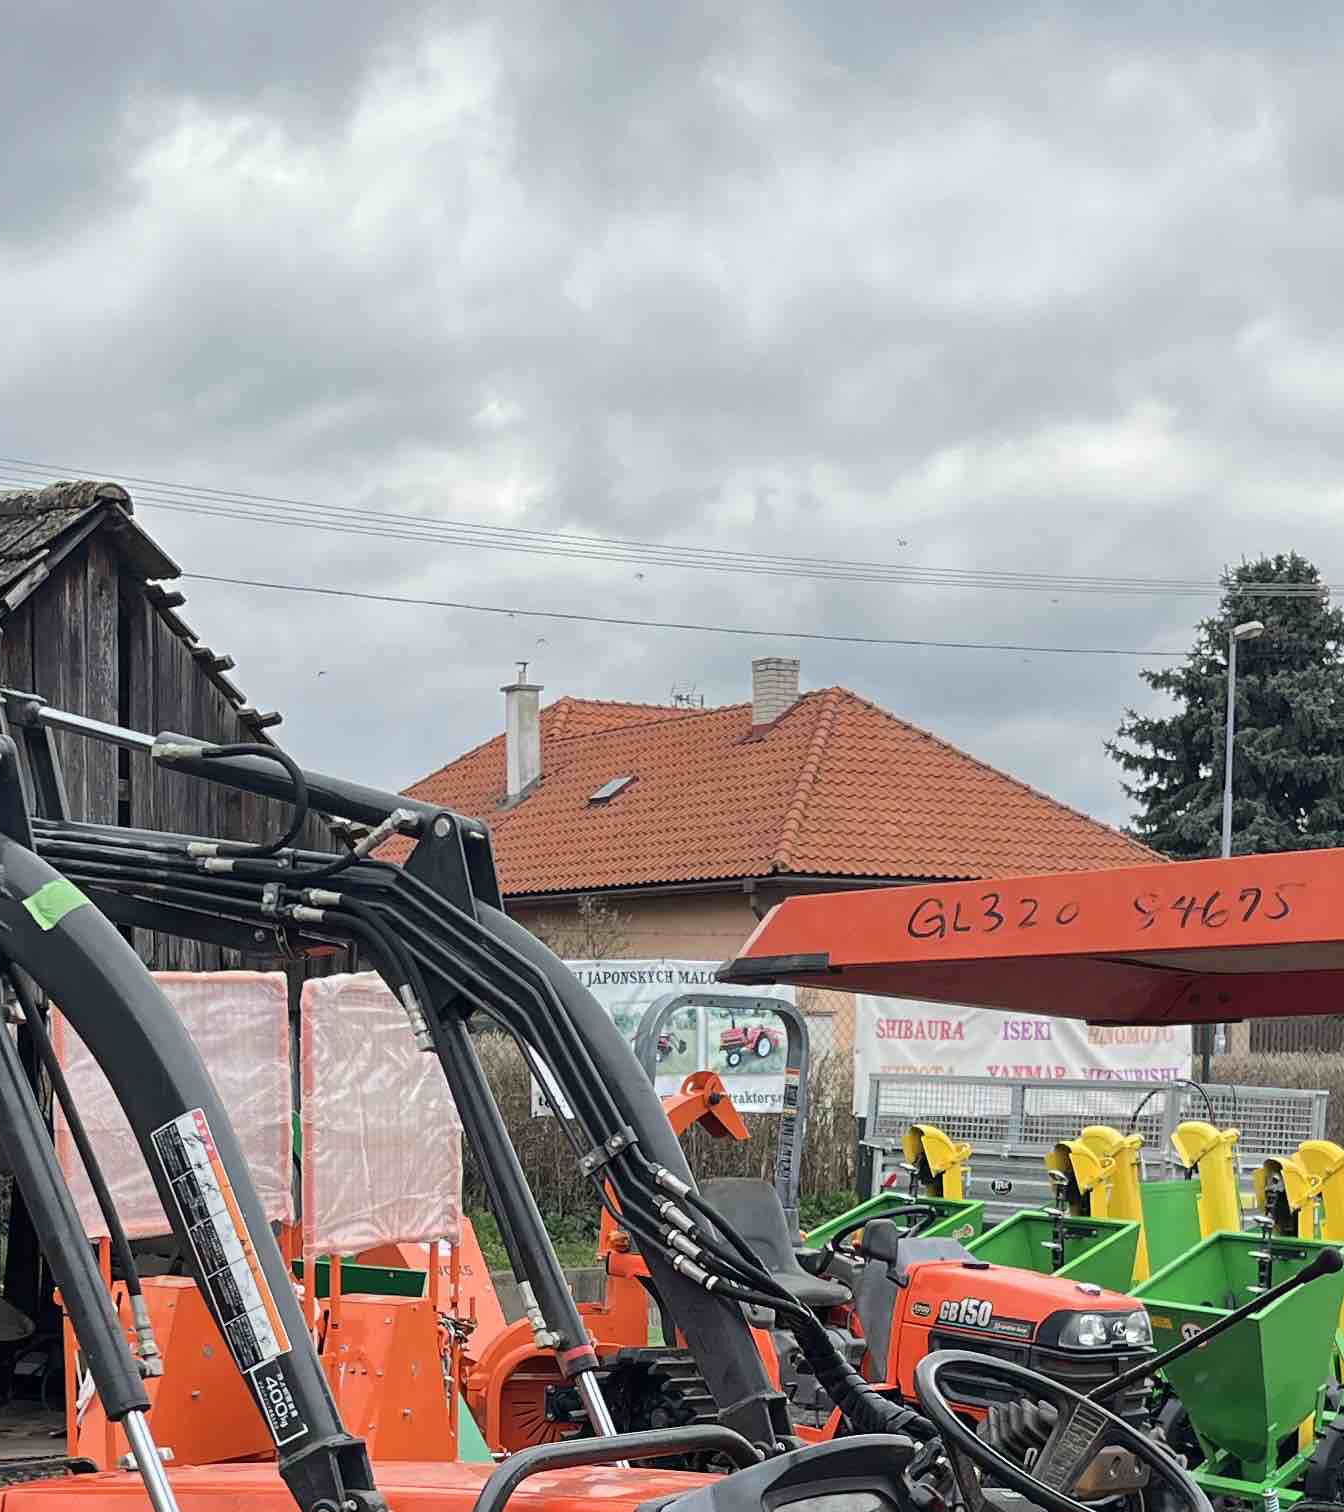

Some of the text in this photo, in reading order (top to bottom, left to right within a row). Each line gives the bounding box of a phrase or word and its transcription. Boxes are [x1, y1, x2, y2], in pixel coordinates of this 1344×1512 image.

[907, 892, 1081, 938] GL320
[678, 970, 717, 985] MALO
[875, 1019, 966, 1041] SHIBAURA
[1002, 1020, 1053, 1042] ISEKI
[938, 1297, 993, 1328] GB150
